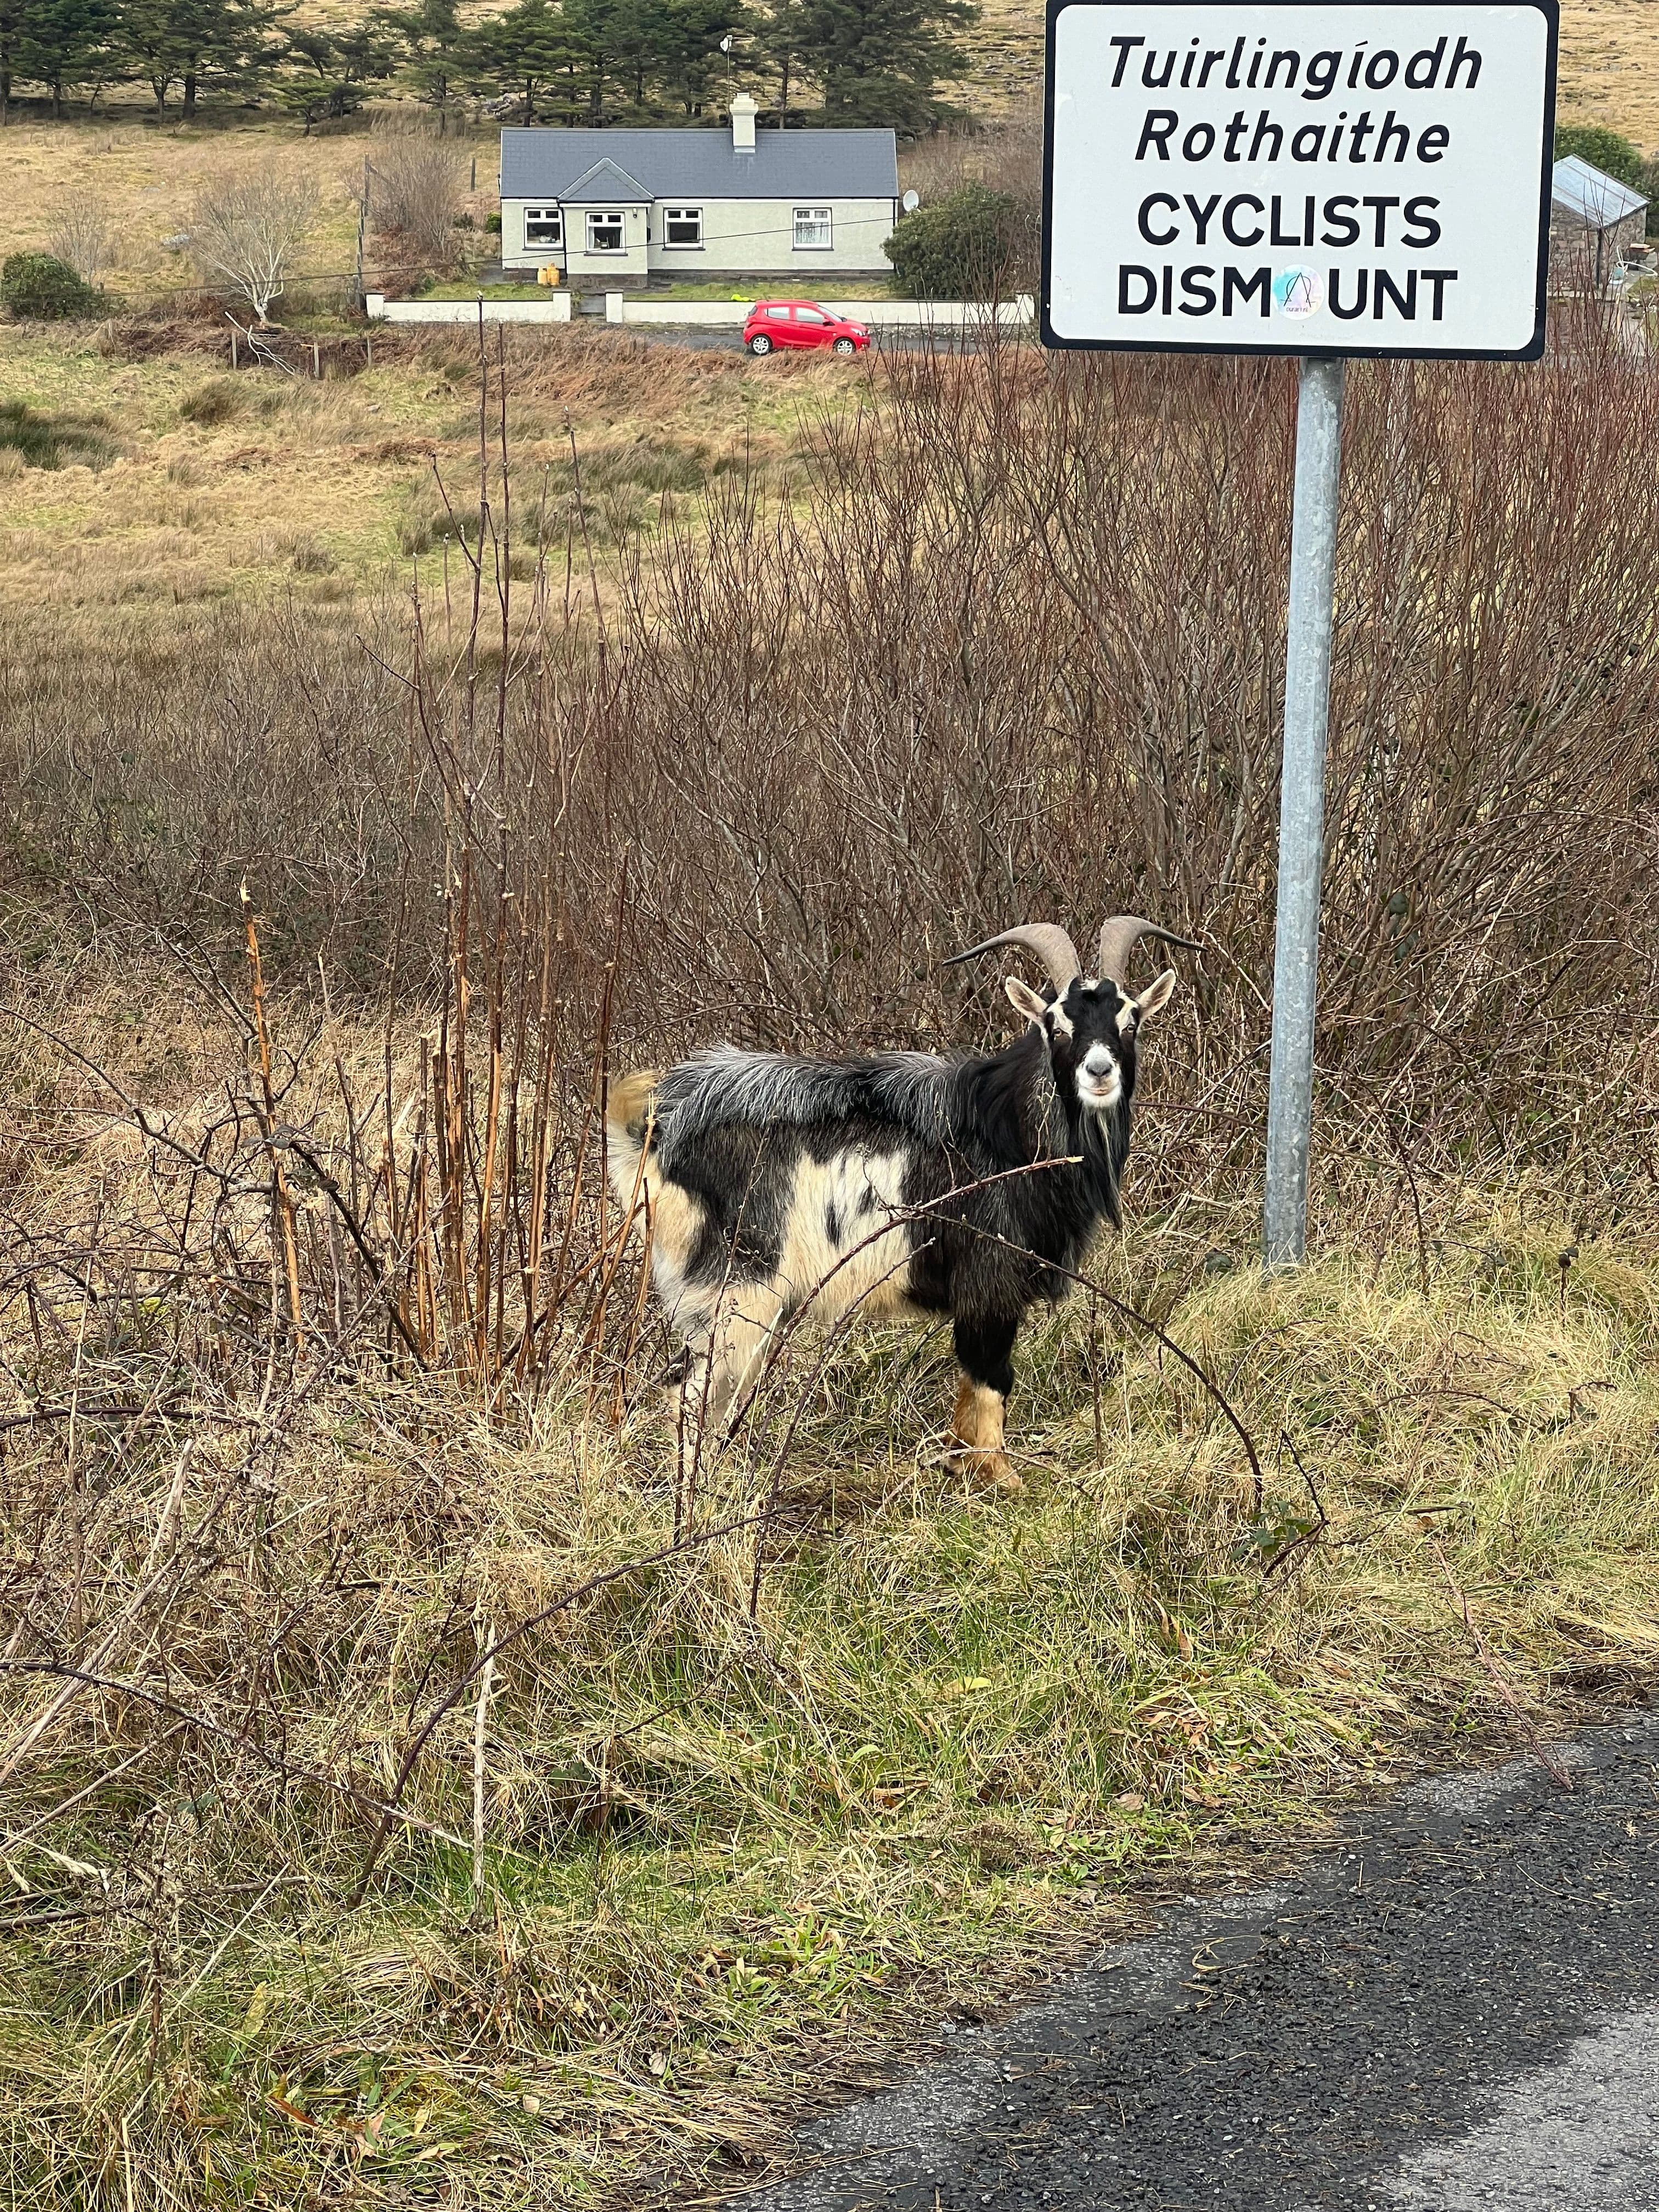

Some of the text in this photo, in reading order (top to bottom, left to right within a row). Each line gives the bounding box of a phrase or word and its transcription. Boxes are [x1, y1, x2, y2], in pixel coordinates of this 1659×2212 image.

[1109, 36, 1482, 100] Tuirlingíodh
[1135, 110, 1449, 163] Rothaithe
[1138, 193, 1441, 249] CYCLISTS
[1118, 264, 1458, 320] DISMUNT
